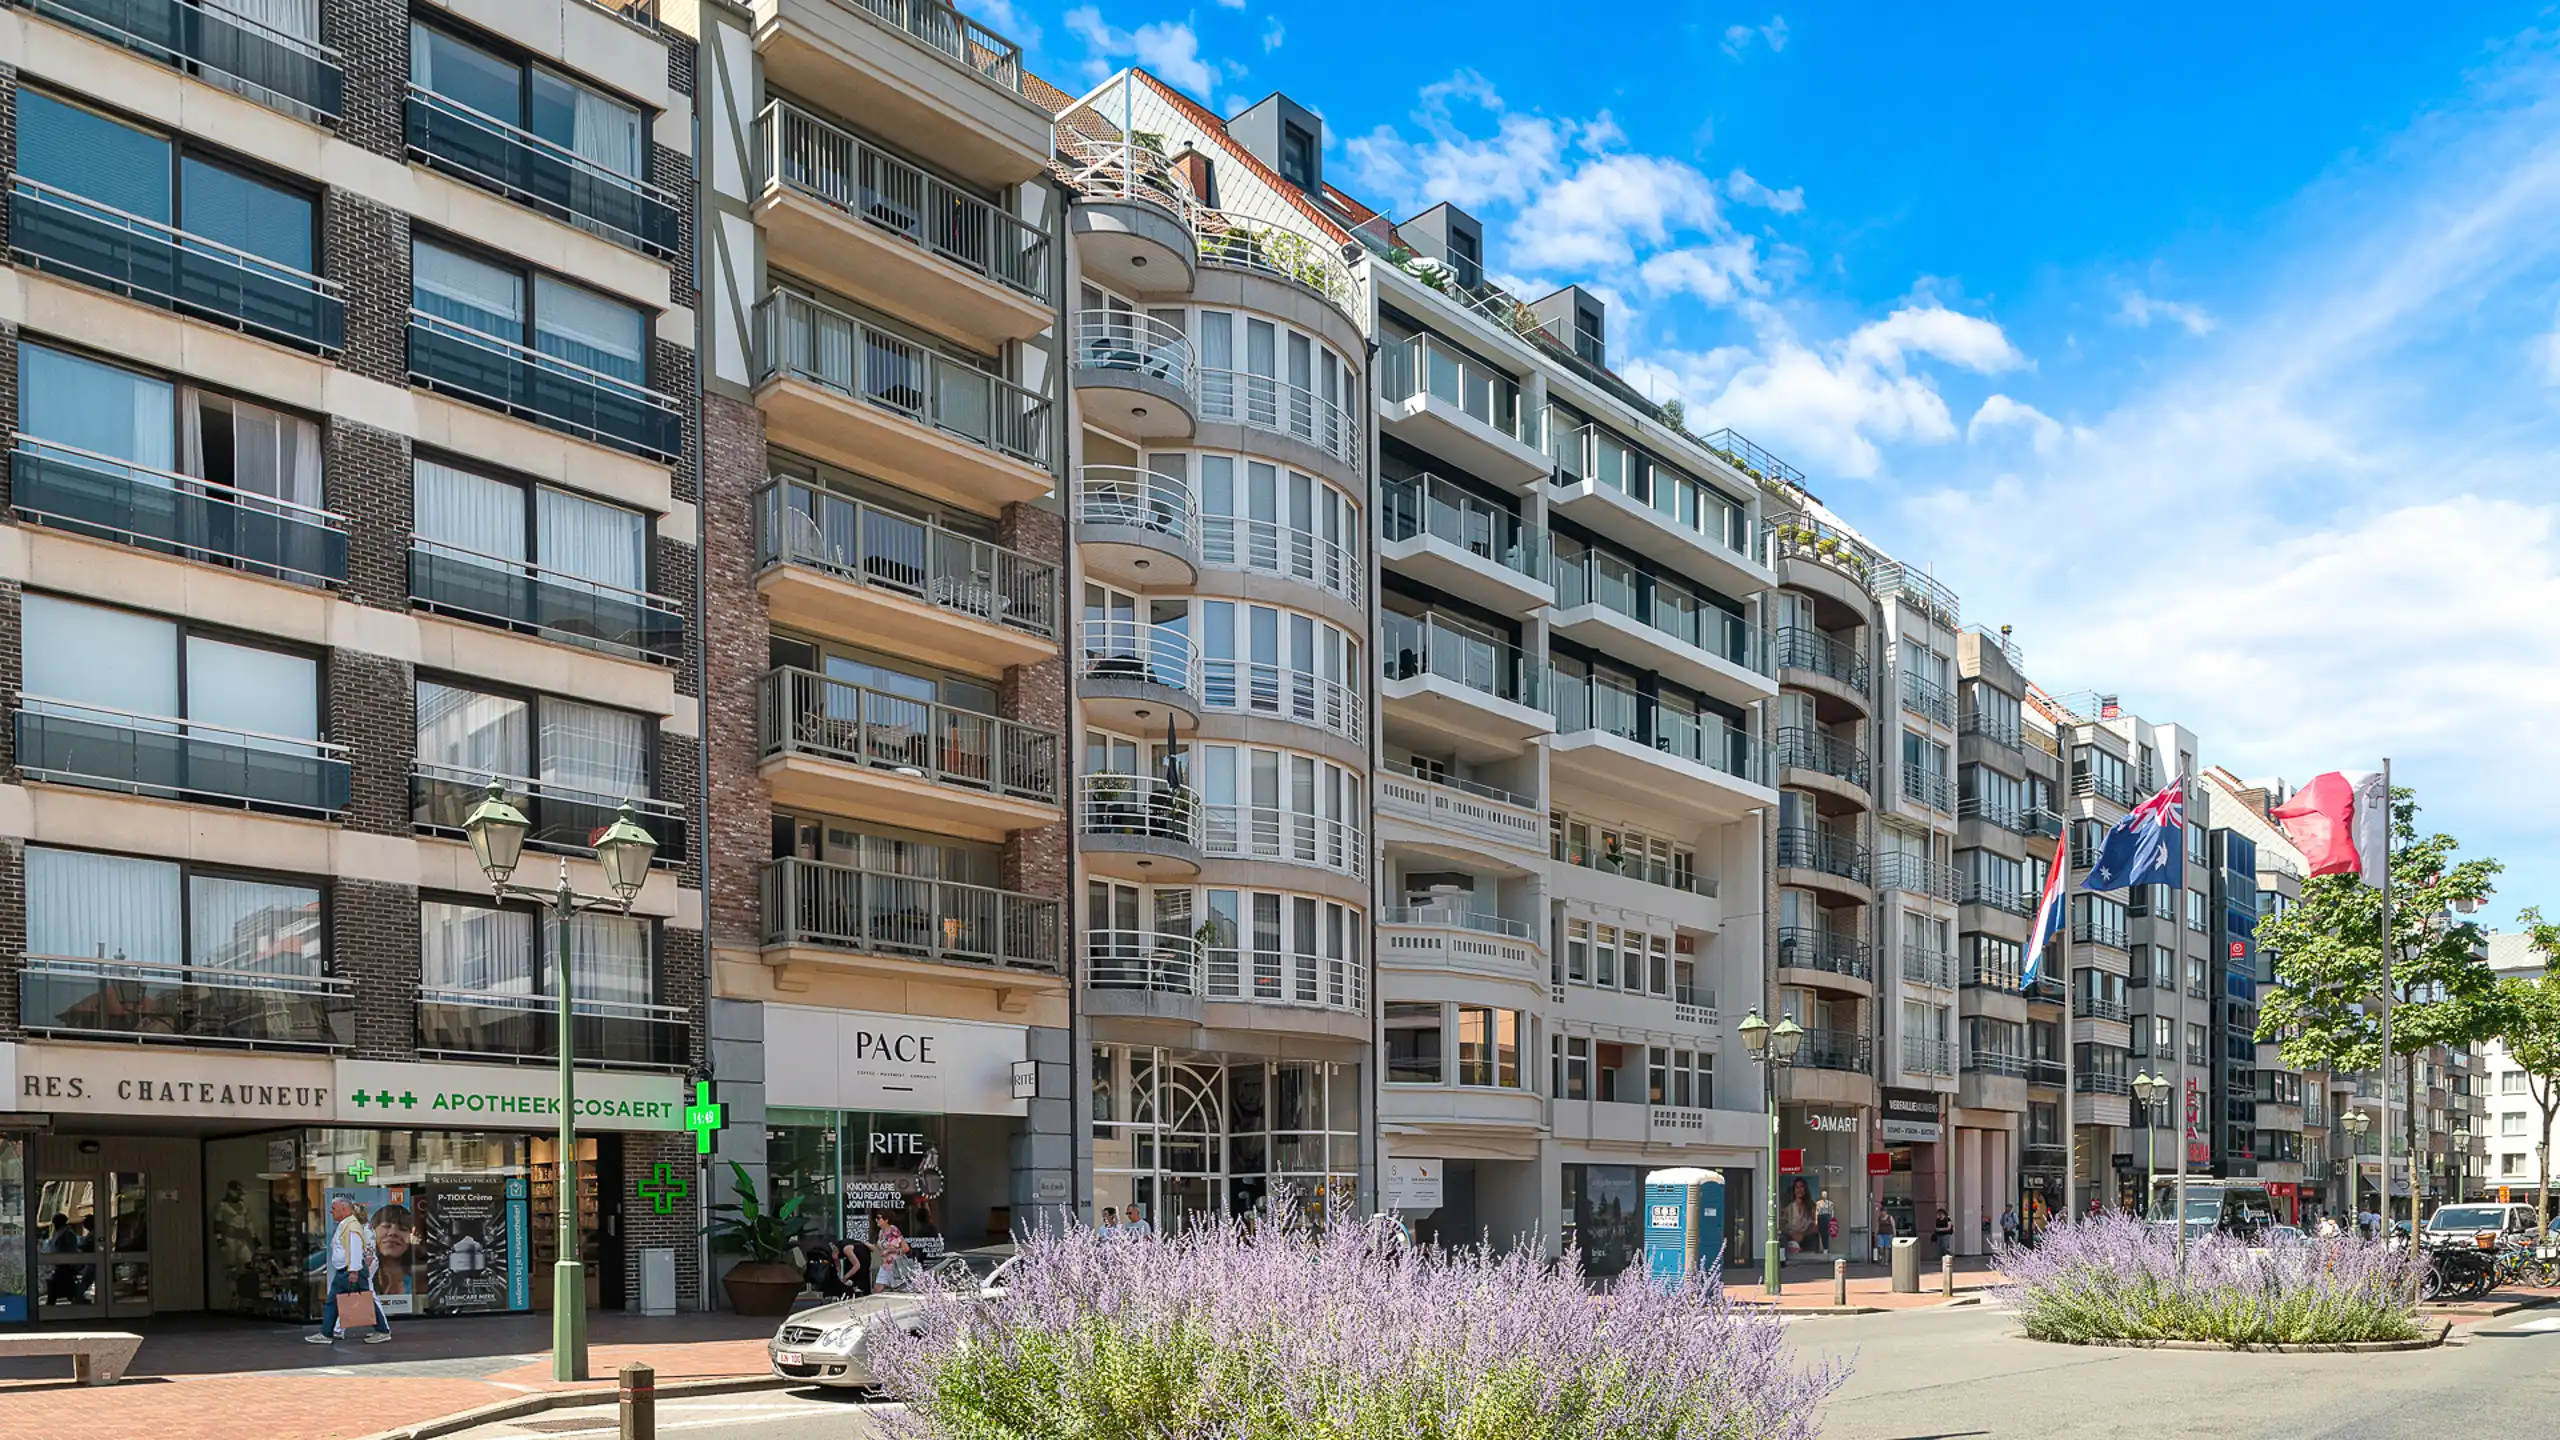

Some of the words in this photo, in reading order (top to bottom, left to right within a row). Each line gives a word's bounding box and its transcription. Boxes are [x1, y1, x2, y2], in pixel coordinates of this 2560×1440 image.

[856, 1031, 936, 1064] PACE
[1014, 1073, 1034, 1086] RITE
[23, 1075, 92, 1099] RES.
[118, 1080, 328, 1107] CHATEAUNEUF
[431, 1092, 560, 1115] APOTHEEK
[572, 1098, 673, 1119] COSAERT
[1810, 1115, 1858, 1132] DAMART
[869, 1132, 924, 1154] RITE
[846, 1191, 864, 1200] YOU
[864, 1191, 890, 1200] READY
[890, 1191, 901, 1200] TO
[846, 1200, 865, 1209] JOIN
[865, 1200, 880, 1209] THE
